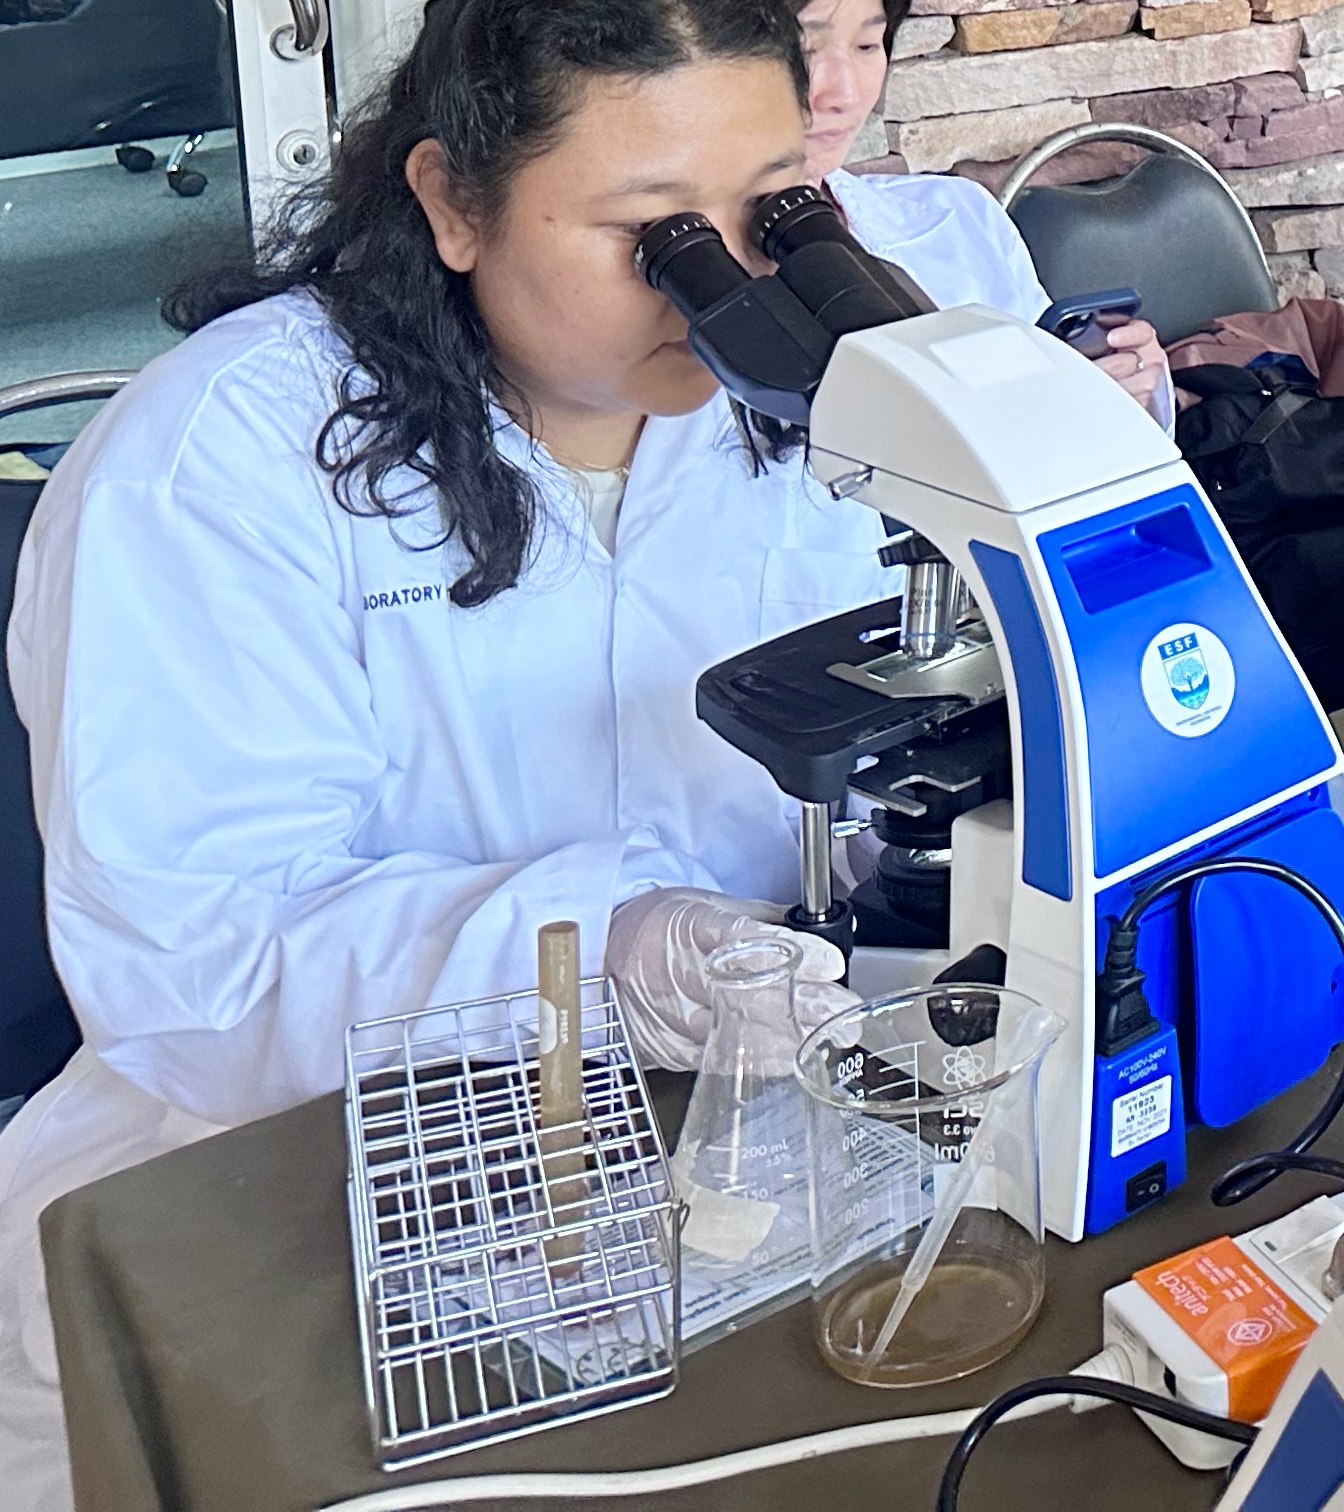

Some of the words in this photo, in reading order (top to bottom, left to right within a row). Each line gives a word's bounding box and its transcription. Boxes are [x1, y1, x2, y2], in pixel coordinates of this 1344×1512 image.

[1163, 635, 1196, 656] ESF
[741, 1144, 768, 1159] 200
[742, 1187, 769, 1201] 150
[752, 1251, 770, 1265] 50
[1155, 1270, 1209, 1317] anitech
